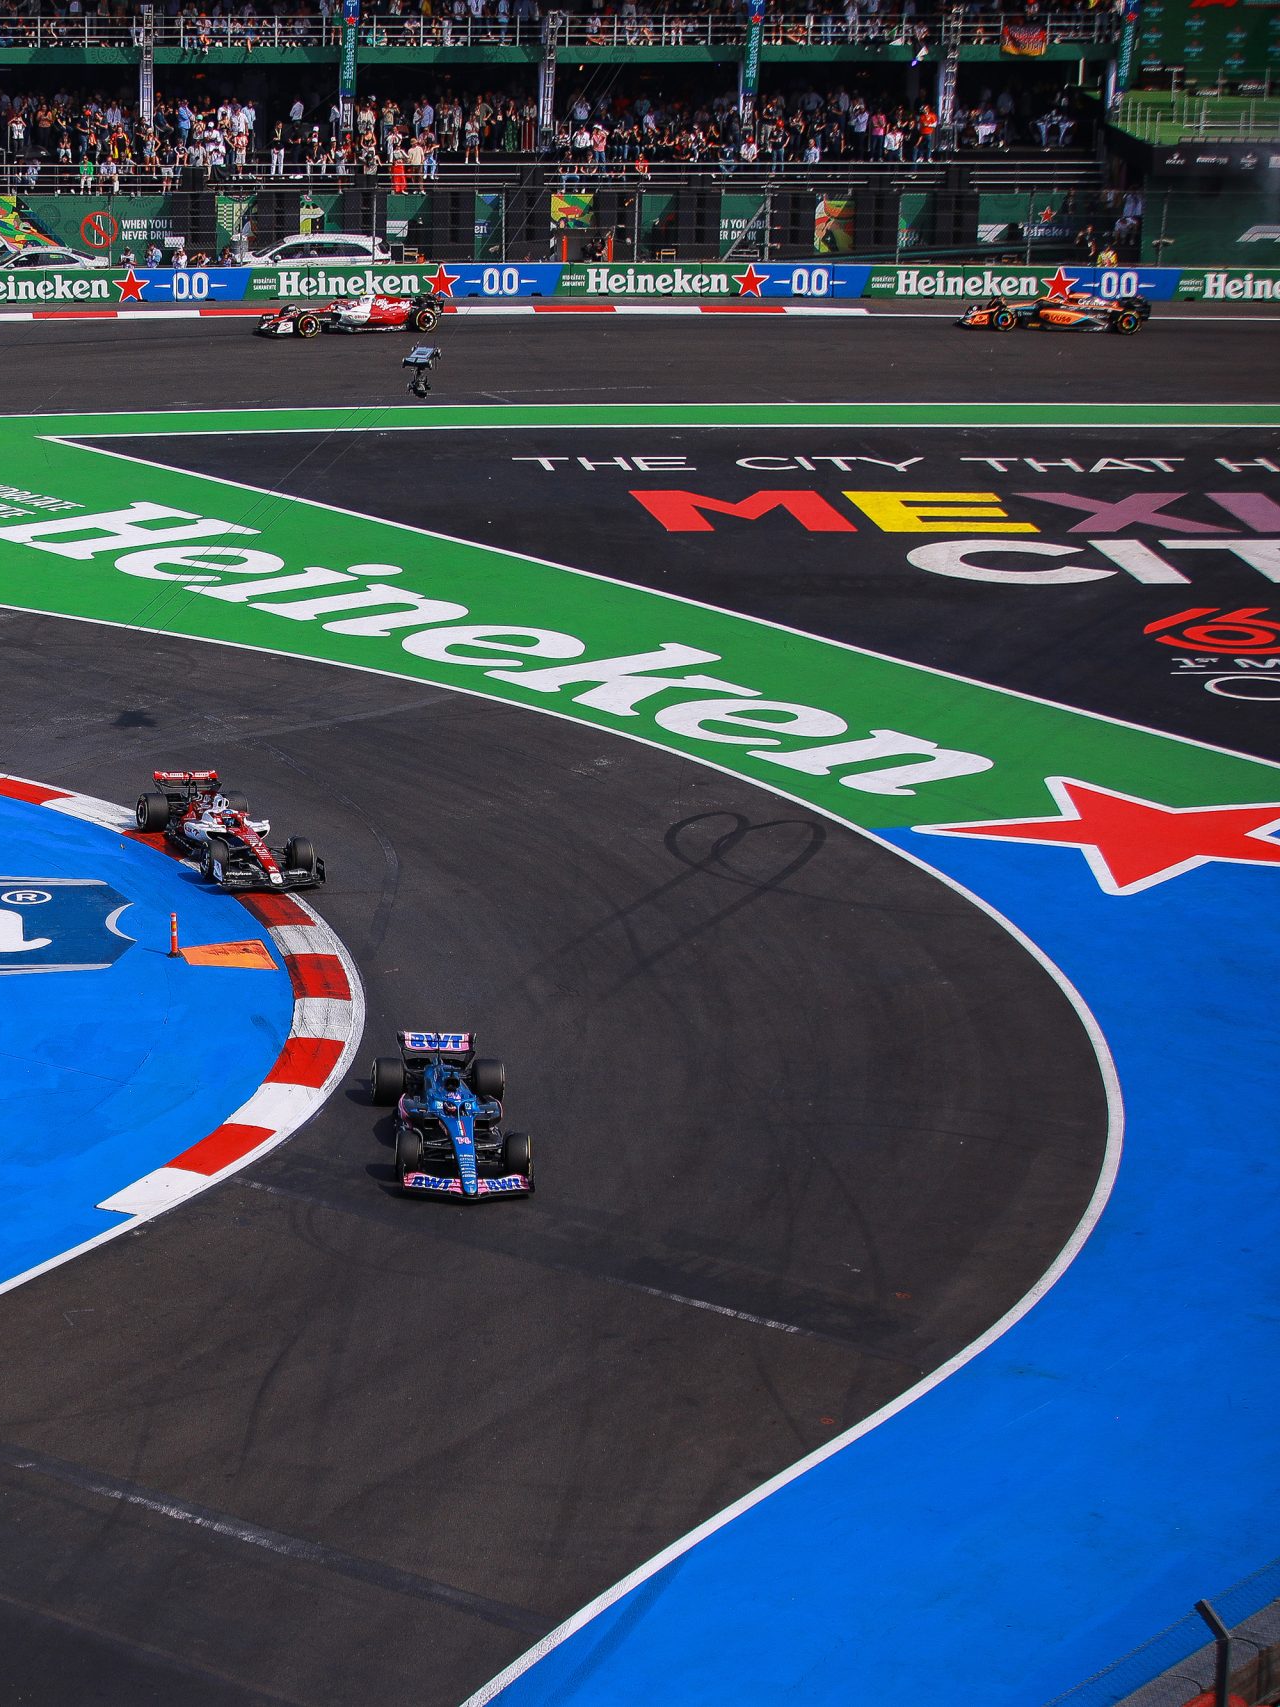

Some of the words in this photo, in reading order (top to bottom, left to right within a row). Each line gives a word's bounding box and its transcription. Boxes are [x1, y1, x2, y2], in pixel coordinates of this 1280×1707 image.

[121, 219, 147, 229] WHEN
[149, 219, 167, 229] YOU
[122, 231, 147, 240] NEVER
[173, 272, 209, 299] 0.0
[277, 270, 420, 296] Heineken
[483, 267, 519, 295] 0.0
[586, 268, 729, 294] Heineken
[791, 268, 829, 296] 0.0
[896, 270, 1038, 297] Heineken
[1100, 272, 1138, 299] 0.0
[512, 456, 697, 471] THE
[736, 456, 925, 471] CITY
[960, 456, 1185, 472] THAT
[410, 1033, 463, 1049] BWT
[412, 1177, 452, 1190] BWT
